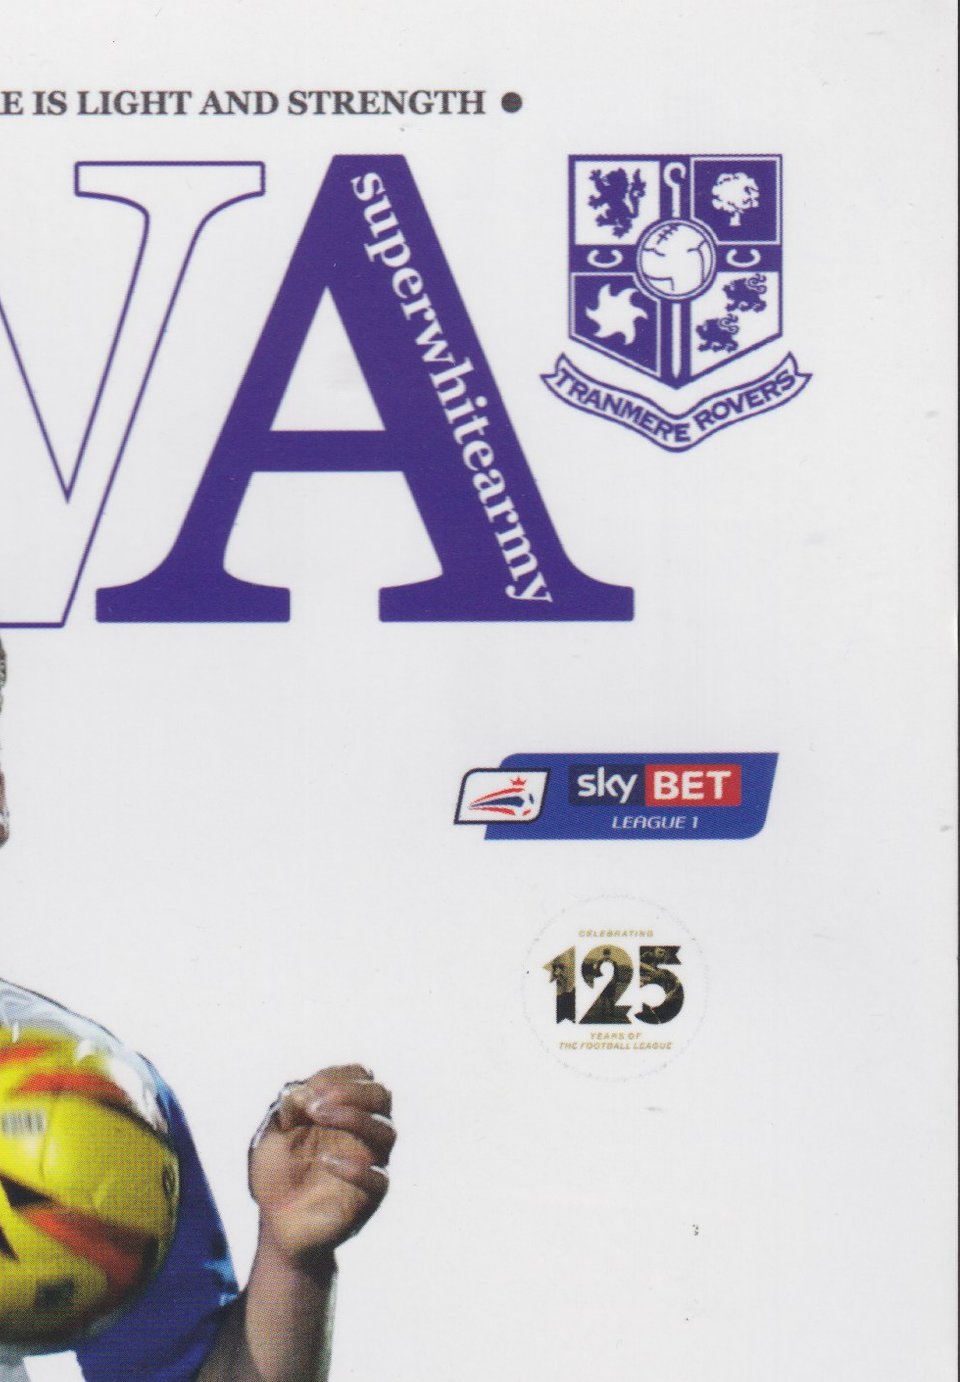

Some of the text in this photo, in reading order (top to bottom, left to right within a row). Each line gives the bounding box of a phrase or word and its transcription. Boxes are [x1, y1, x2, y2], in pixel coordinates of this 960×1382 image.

[31, 88, 70, 118] IS
[75, 88, 193, 118] LIGHT
[198, 88, 280, 118] AND
[286, 88, 487, 118] STRENGTH
[349, 171, 553, 604] superwhitearmy
[554, 367, 797, 444] TRANMERE ROVERS
[576, 766, 733, 805] sky BET
[611, 815, 700, 830] LEAGUE 1
[578, 929, 654, 938] CELEBRATING
[542, 943, 685, 1025] 125
[559, 1042, 673, 1050] THE FOOTBALL LEAGUE
[590, 1032, 641, 1040] YEARS OF
